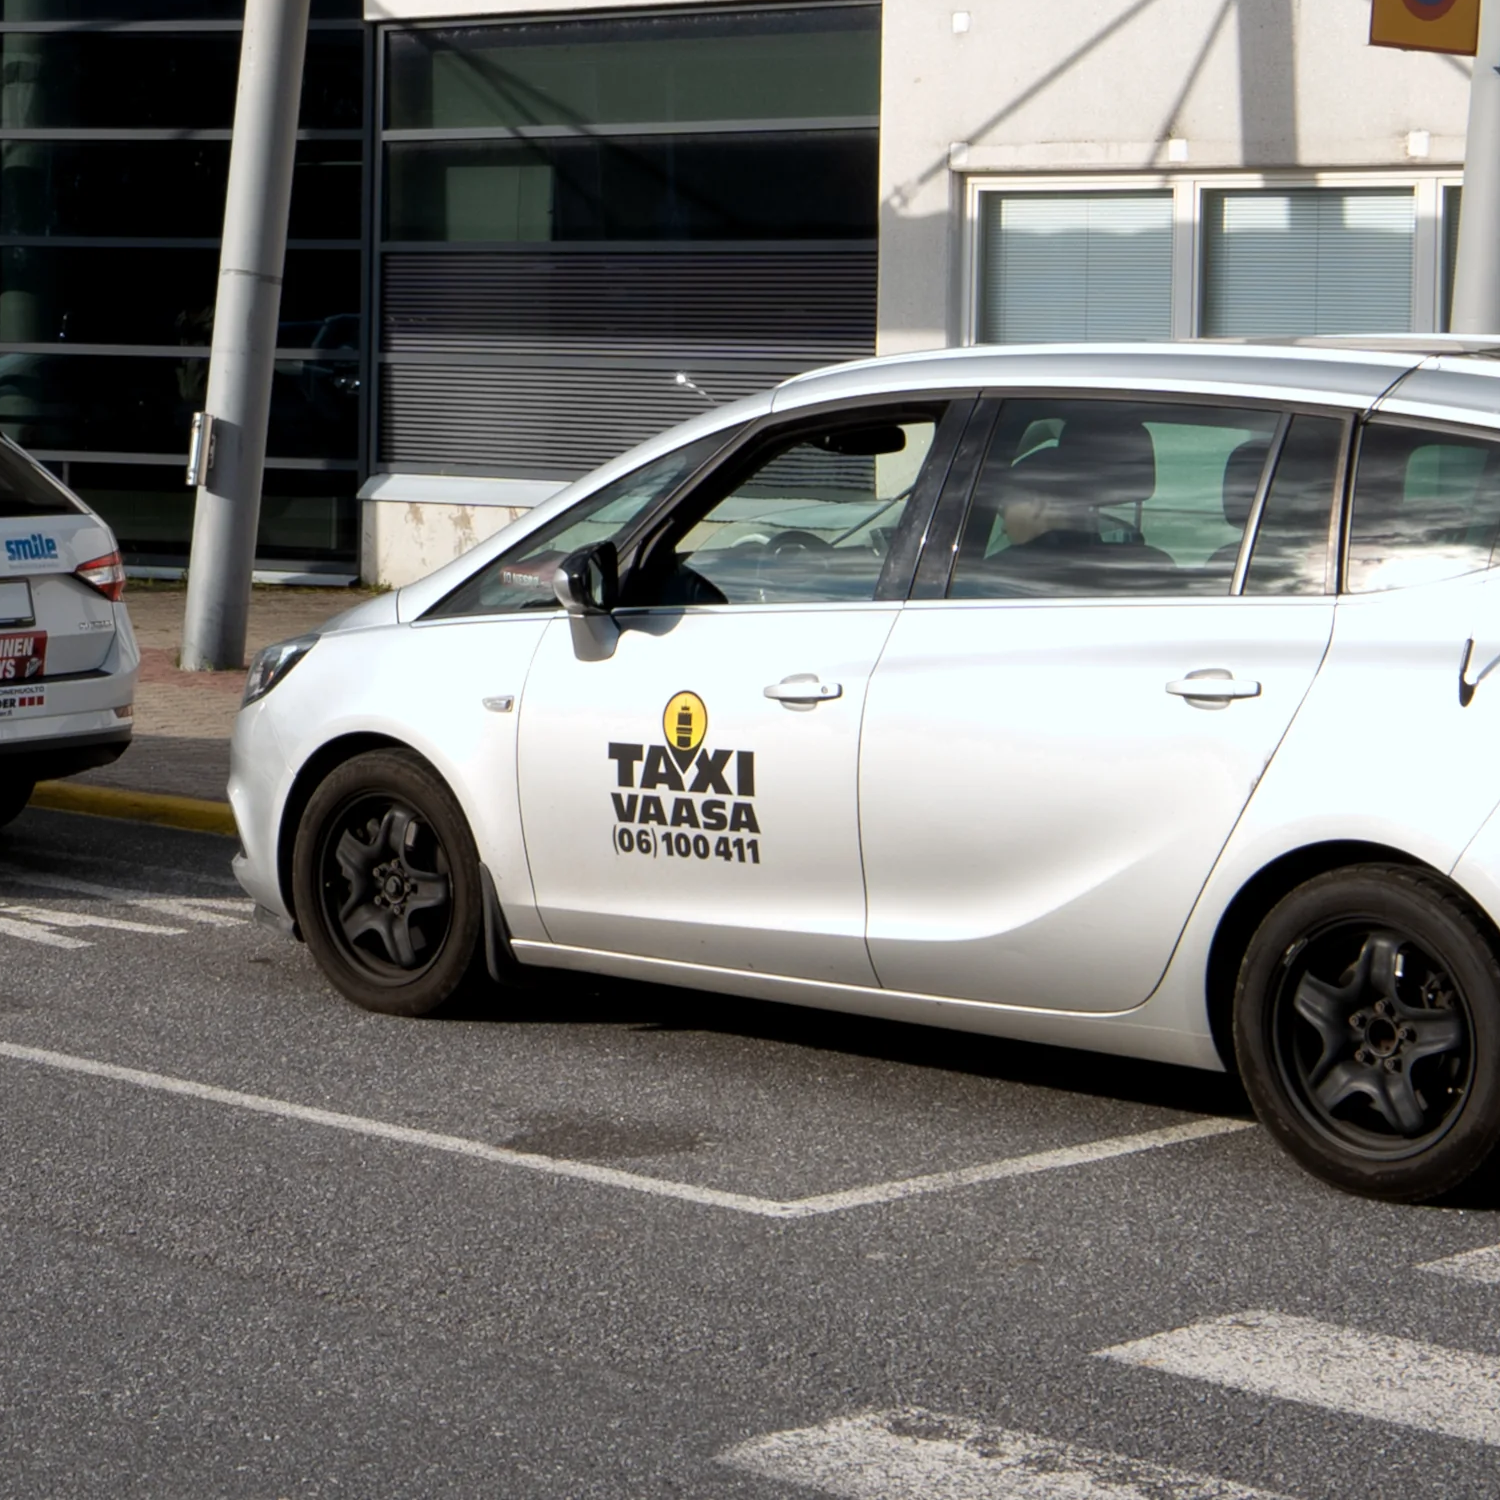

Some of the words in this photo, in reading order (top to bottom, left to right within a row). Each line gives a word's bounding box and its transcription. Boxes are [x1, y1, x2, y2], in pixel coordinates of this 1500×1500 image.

[4, 533, 58, 562] smile
[608, 742, 756, 797] TAXI
[610, 792, 762, 834] VAASA
[613, 824, 658, 859] (06)
